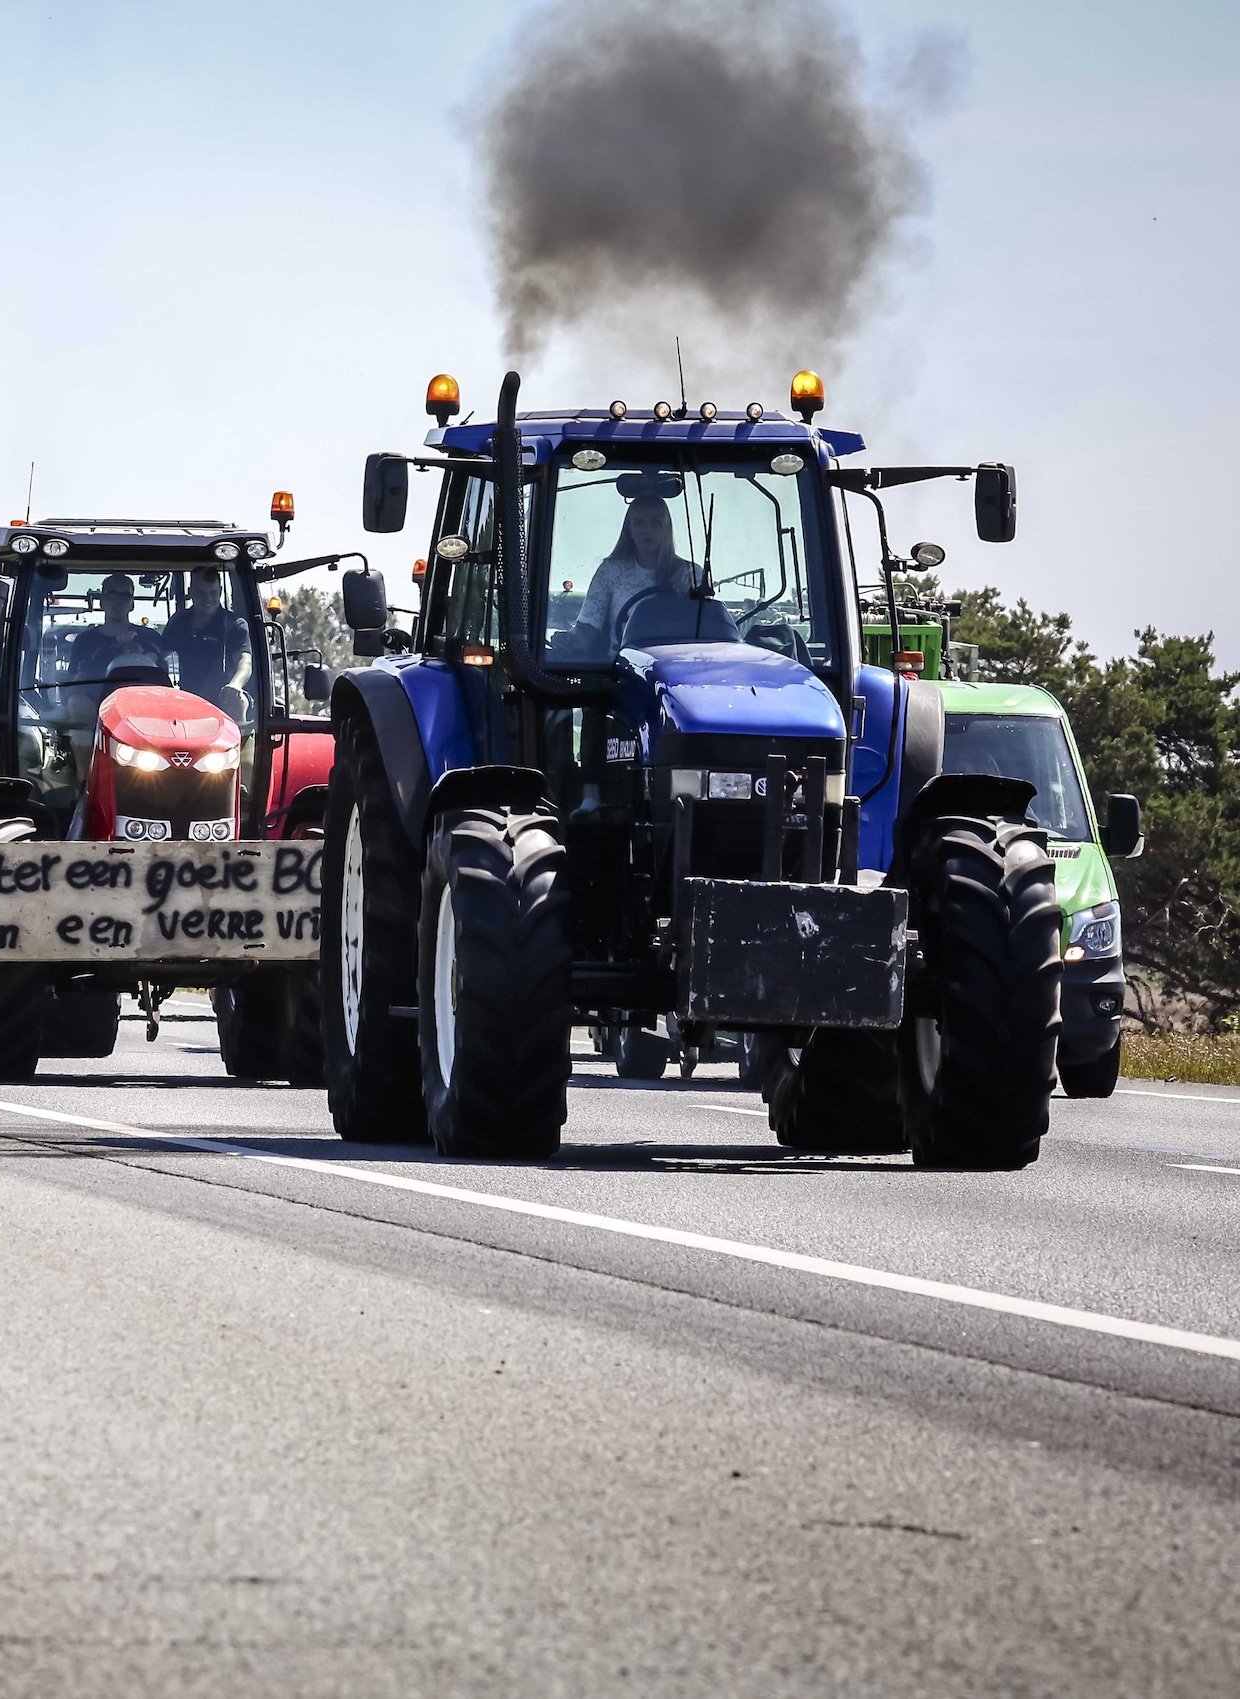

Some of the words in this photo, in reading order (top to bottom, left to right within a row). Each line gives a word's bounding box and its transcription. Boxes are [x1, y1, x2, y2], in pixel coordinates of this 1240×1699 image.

[65, 860, 133, 889] een
[143, 851, 258, 915] goeie
[56, 915, 133, 946] een
